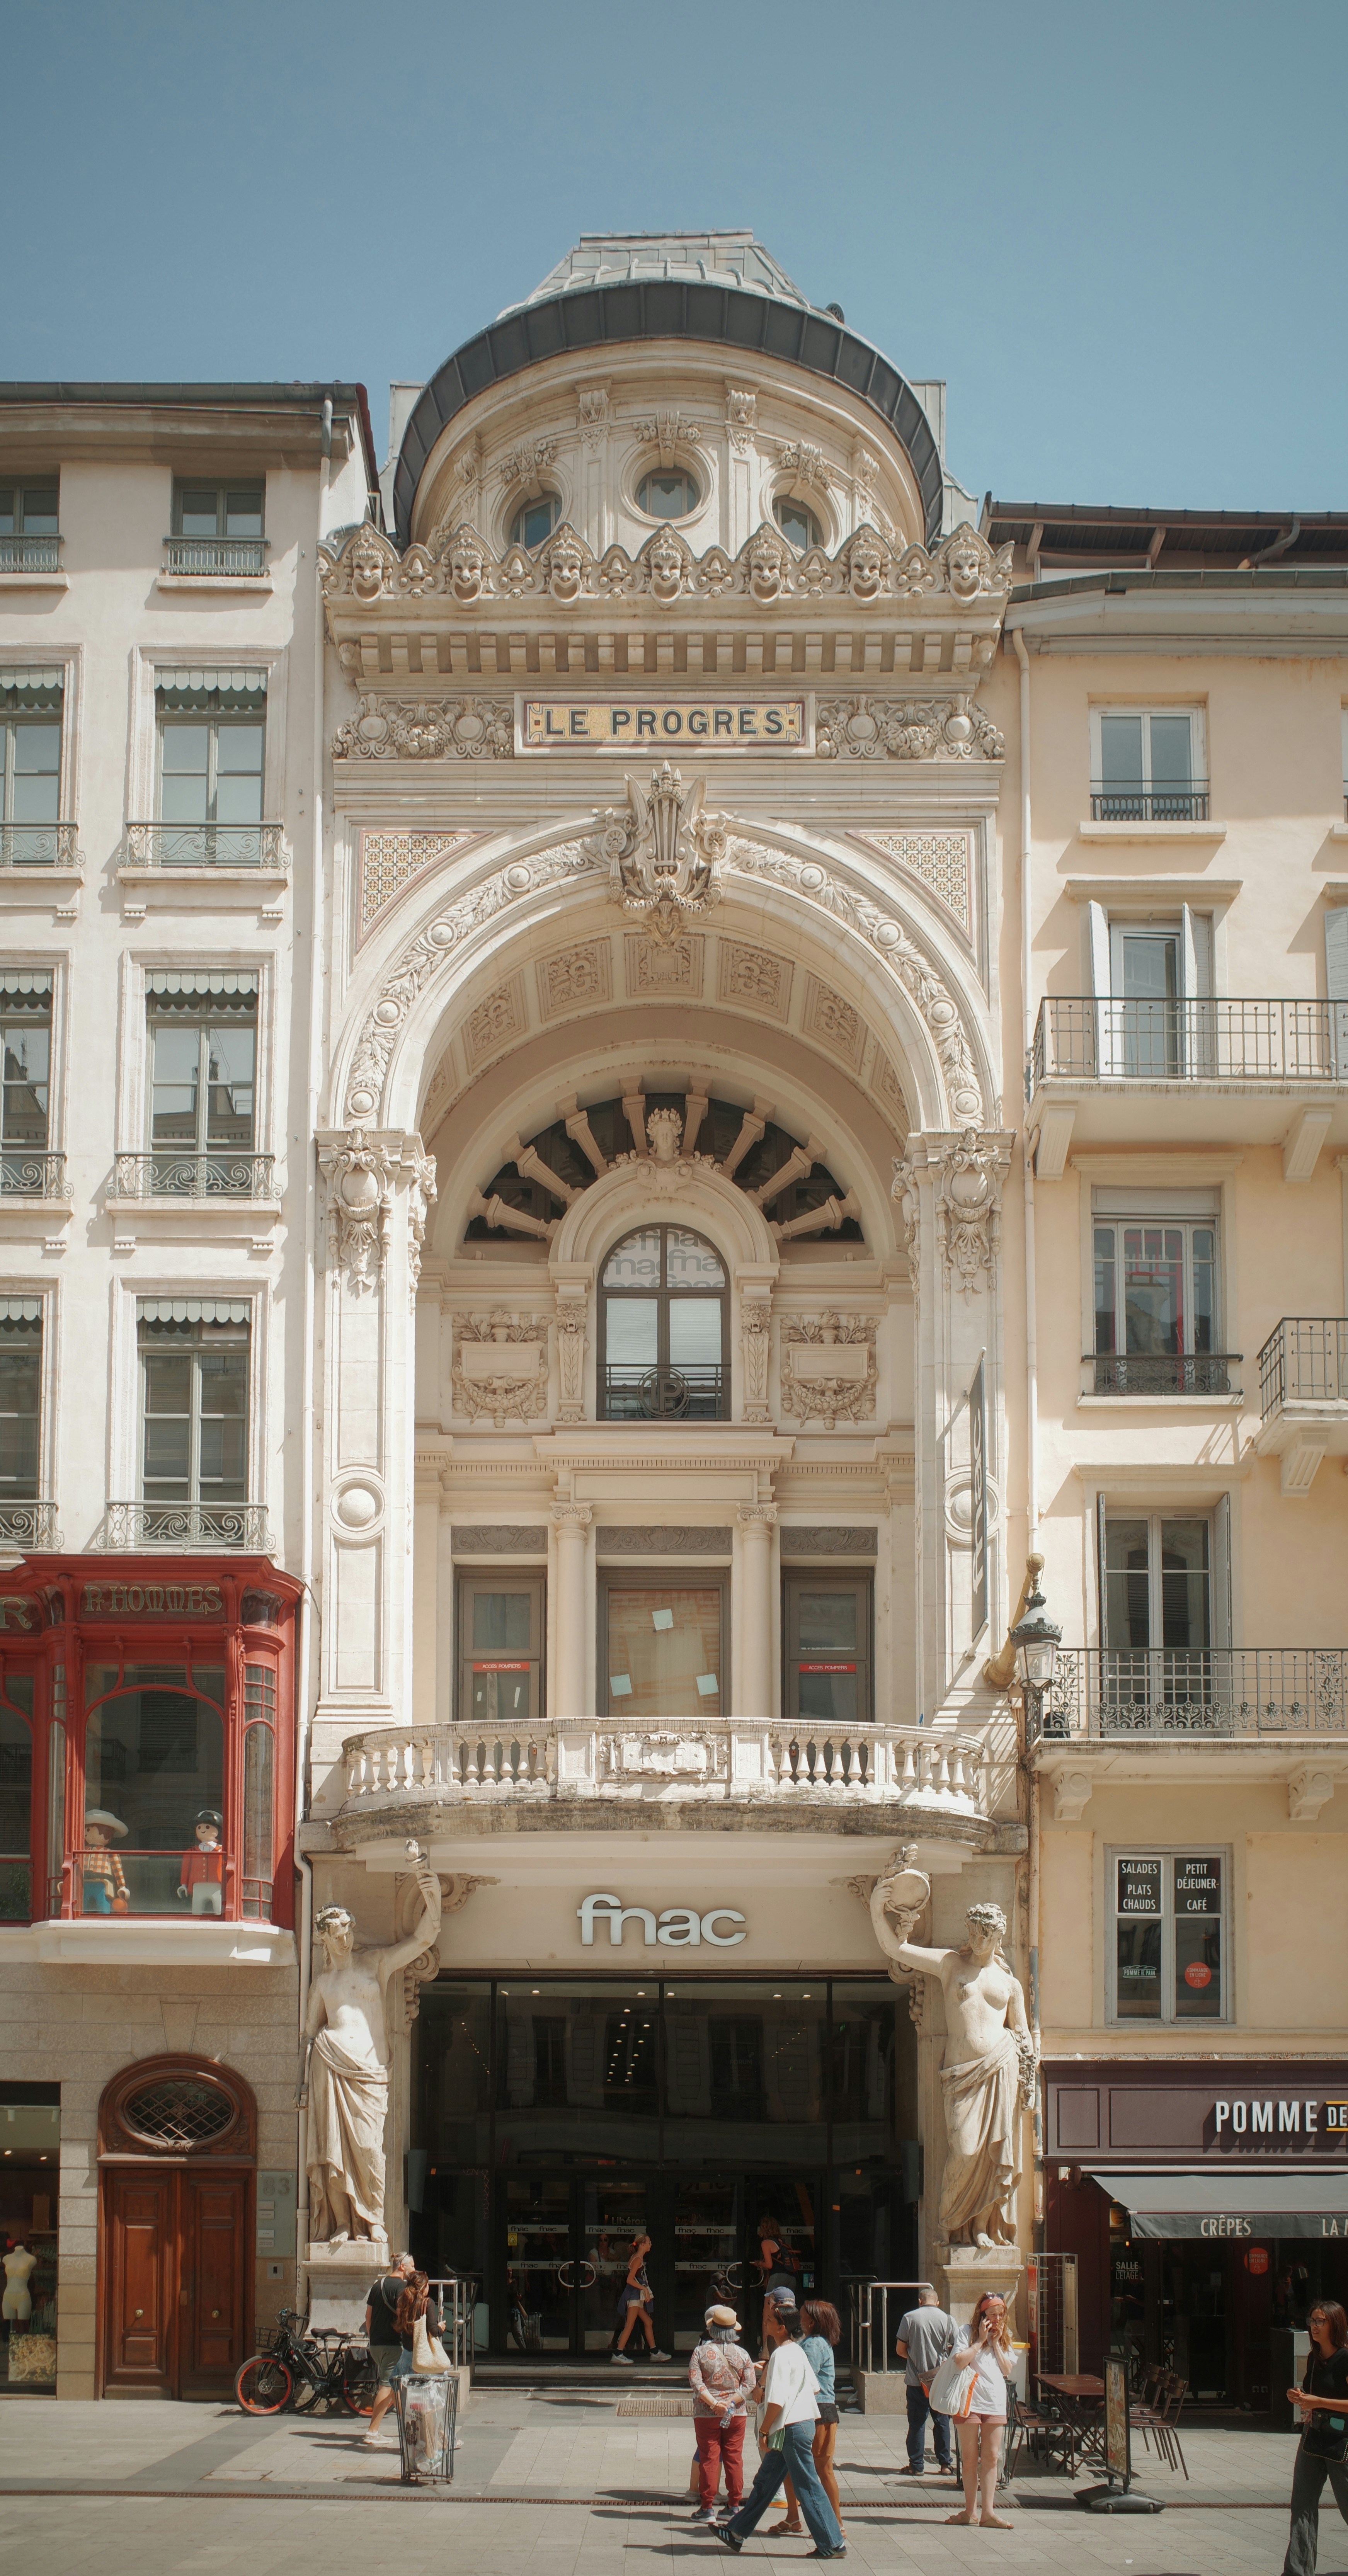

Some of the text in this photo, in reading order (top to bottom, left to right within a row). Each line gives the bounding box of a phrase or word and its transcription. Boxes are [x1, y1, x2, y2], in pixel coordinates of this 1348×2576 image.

[545, 709, 589, 737] LE
[973, 1408, 983, 1595] fnac
[109, 1586, 223, 1615] HOMMES
[1122, 1863, 1157, 1874] SALADES
[1186, 1864, 1208, 1875] PETIT
[1127, 1884, 1152, 1895] PLATS
[1177, 1876, 1217, 1889] DÉJEUNER
[1123, 1899, 1156, 1910] CHAUDS
[1187, 1897, 1207, 1911] CAFÉ
[577, 1894, 747, 1947] fnac
[1216, 2101, 1348, 2133] POMME DE
[264, 2177, 290, 2196] 83
[1200, 2214, 1252, 2236] CRÊPES
[1322, 2219, 1339, 2236] LA
[1116, 2261, 1139, 2270] SALLE
